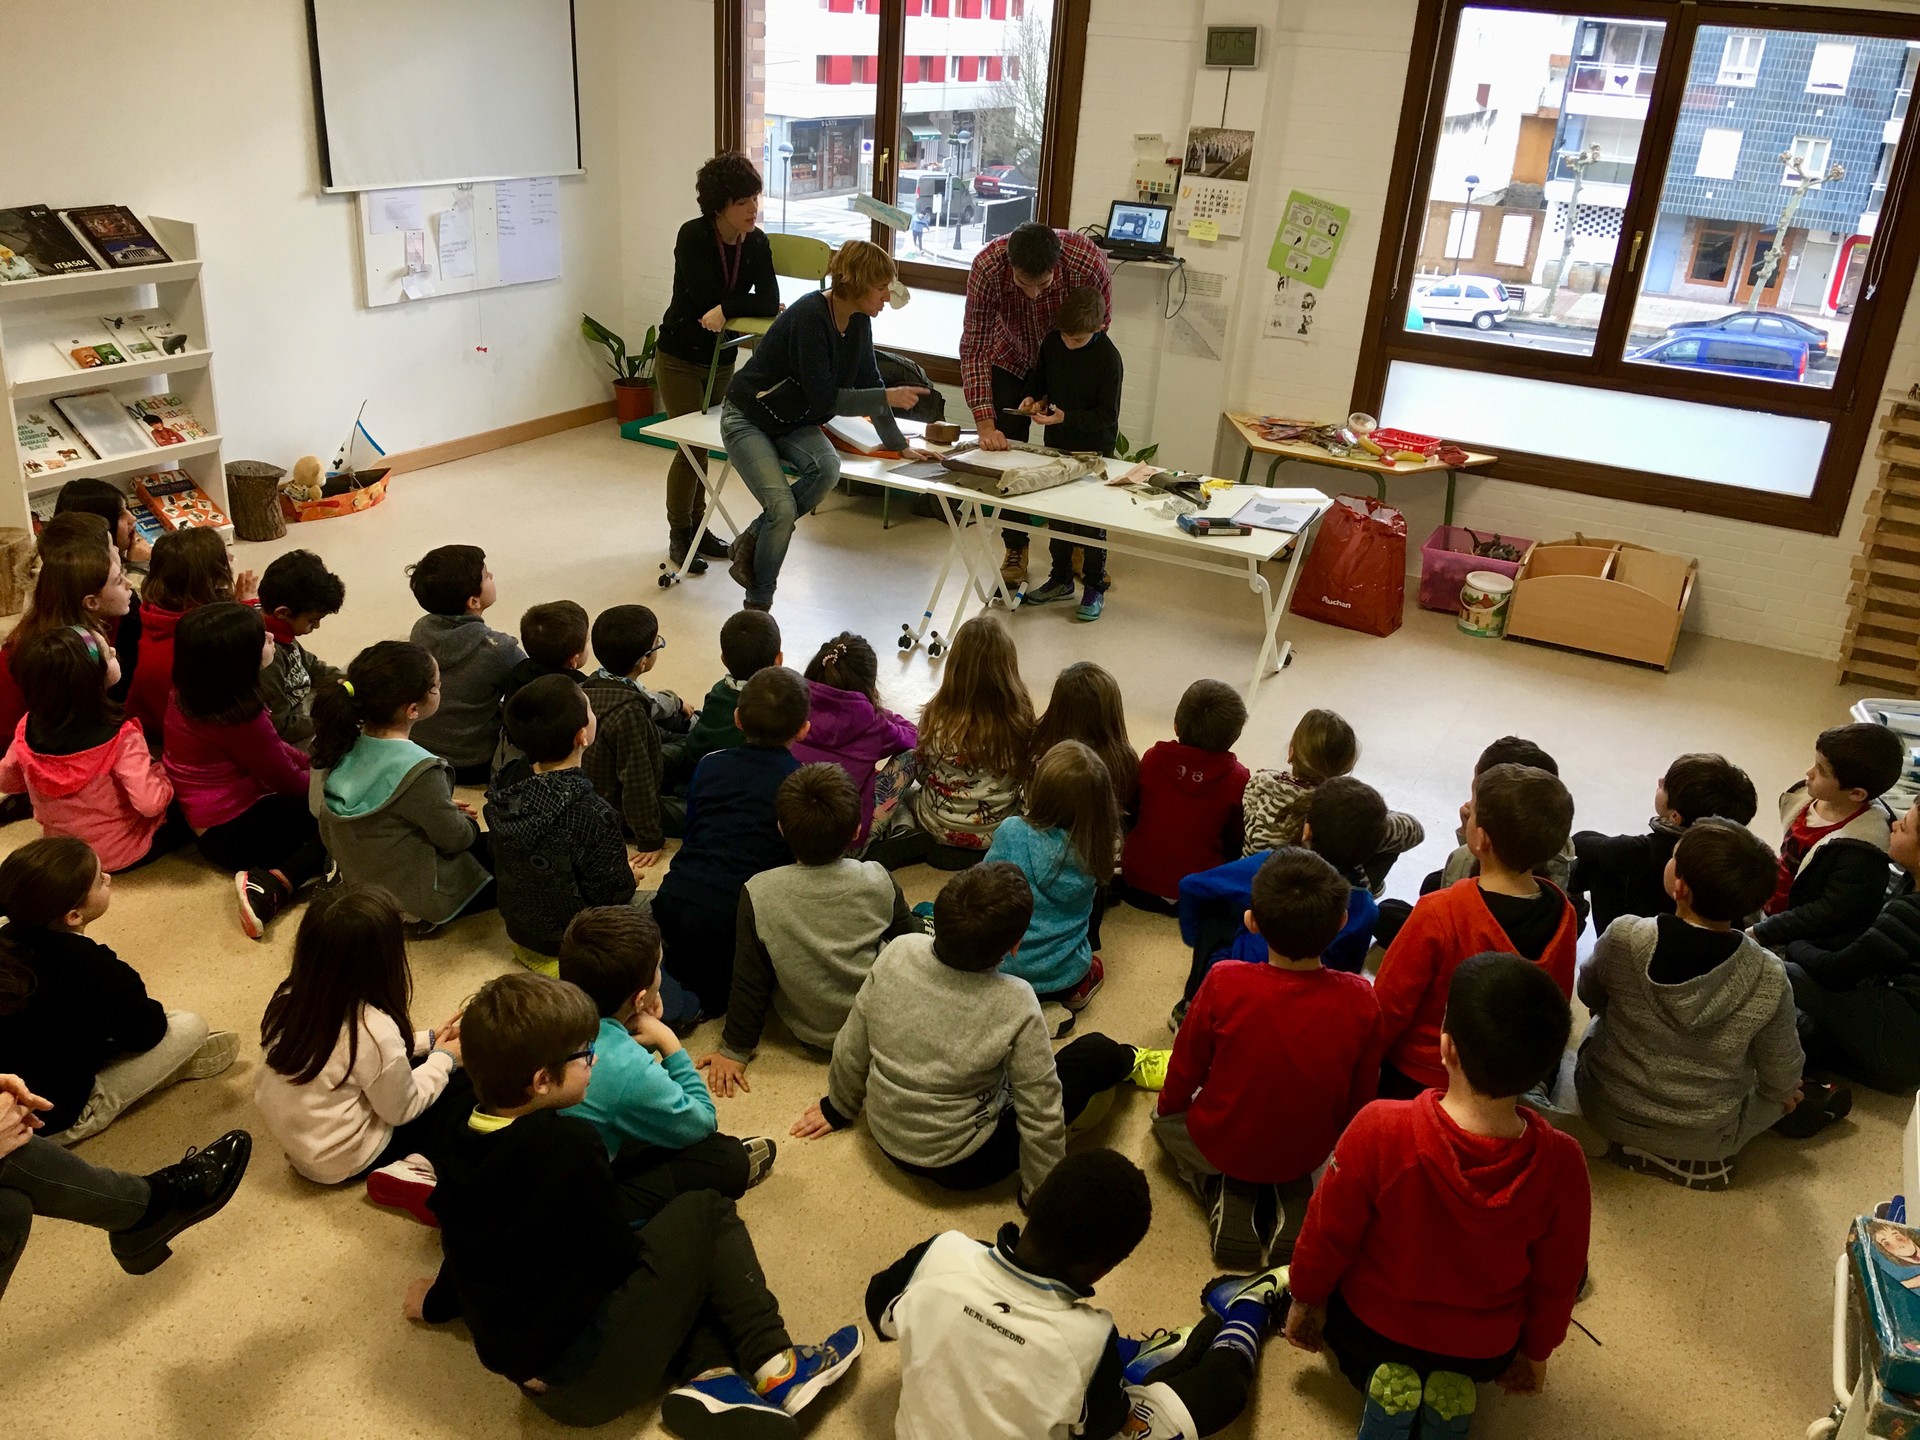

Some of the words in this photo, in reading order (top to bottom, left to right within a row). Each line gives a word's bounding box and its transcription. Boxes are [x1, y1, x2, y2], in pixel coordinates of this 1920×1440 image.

[54, 259, 90, 270] ITSASOA
[1321, 595, 1352, 609] Auchan
[963, 1305, 984, 1323] REAL
[985, 1318, 1026, 1346] SOCIEDAD
